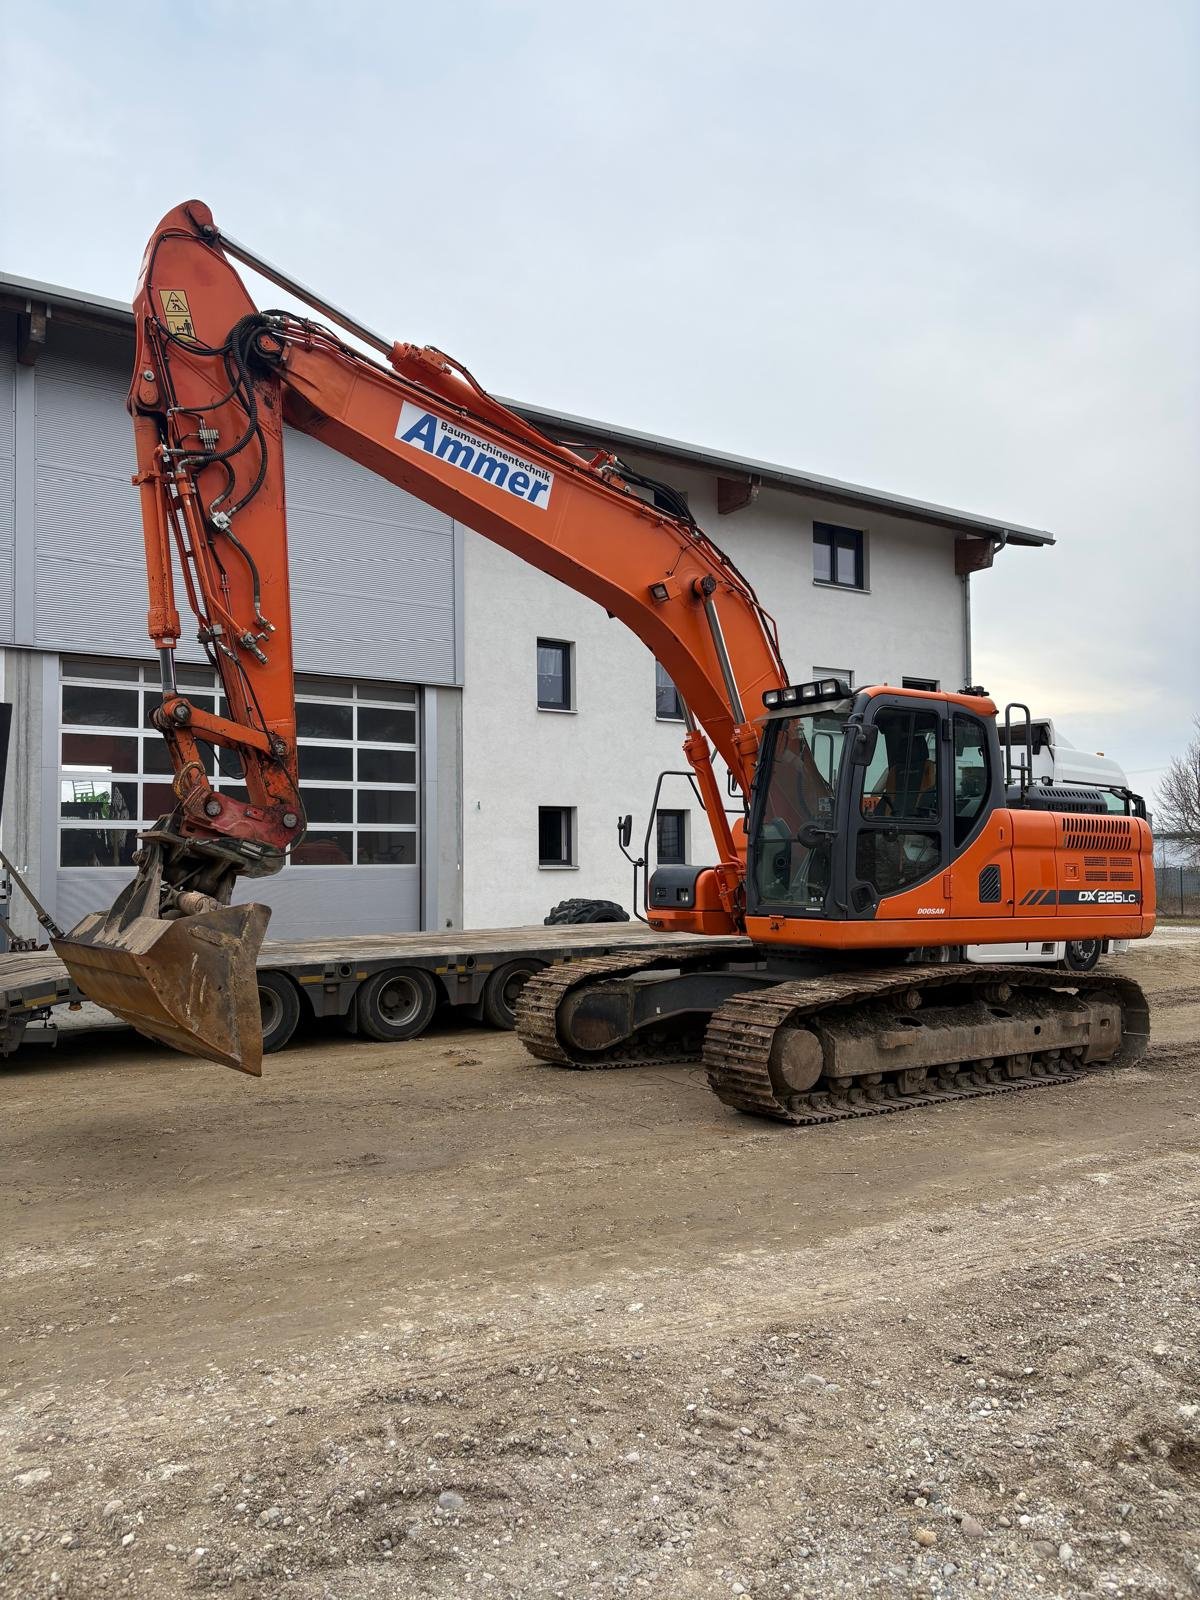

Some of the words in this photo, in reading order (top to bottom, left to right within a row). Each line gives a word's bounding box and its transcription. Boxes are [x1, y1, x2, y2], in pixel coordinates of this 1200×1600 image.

[401, 413, 548, 502] Ammer
[440, 421, 550, 482] Baumaschinentechnik
[917, 907, 945, 915] DOOSAN
